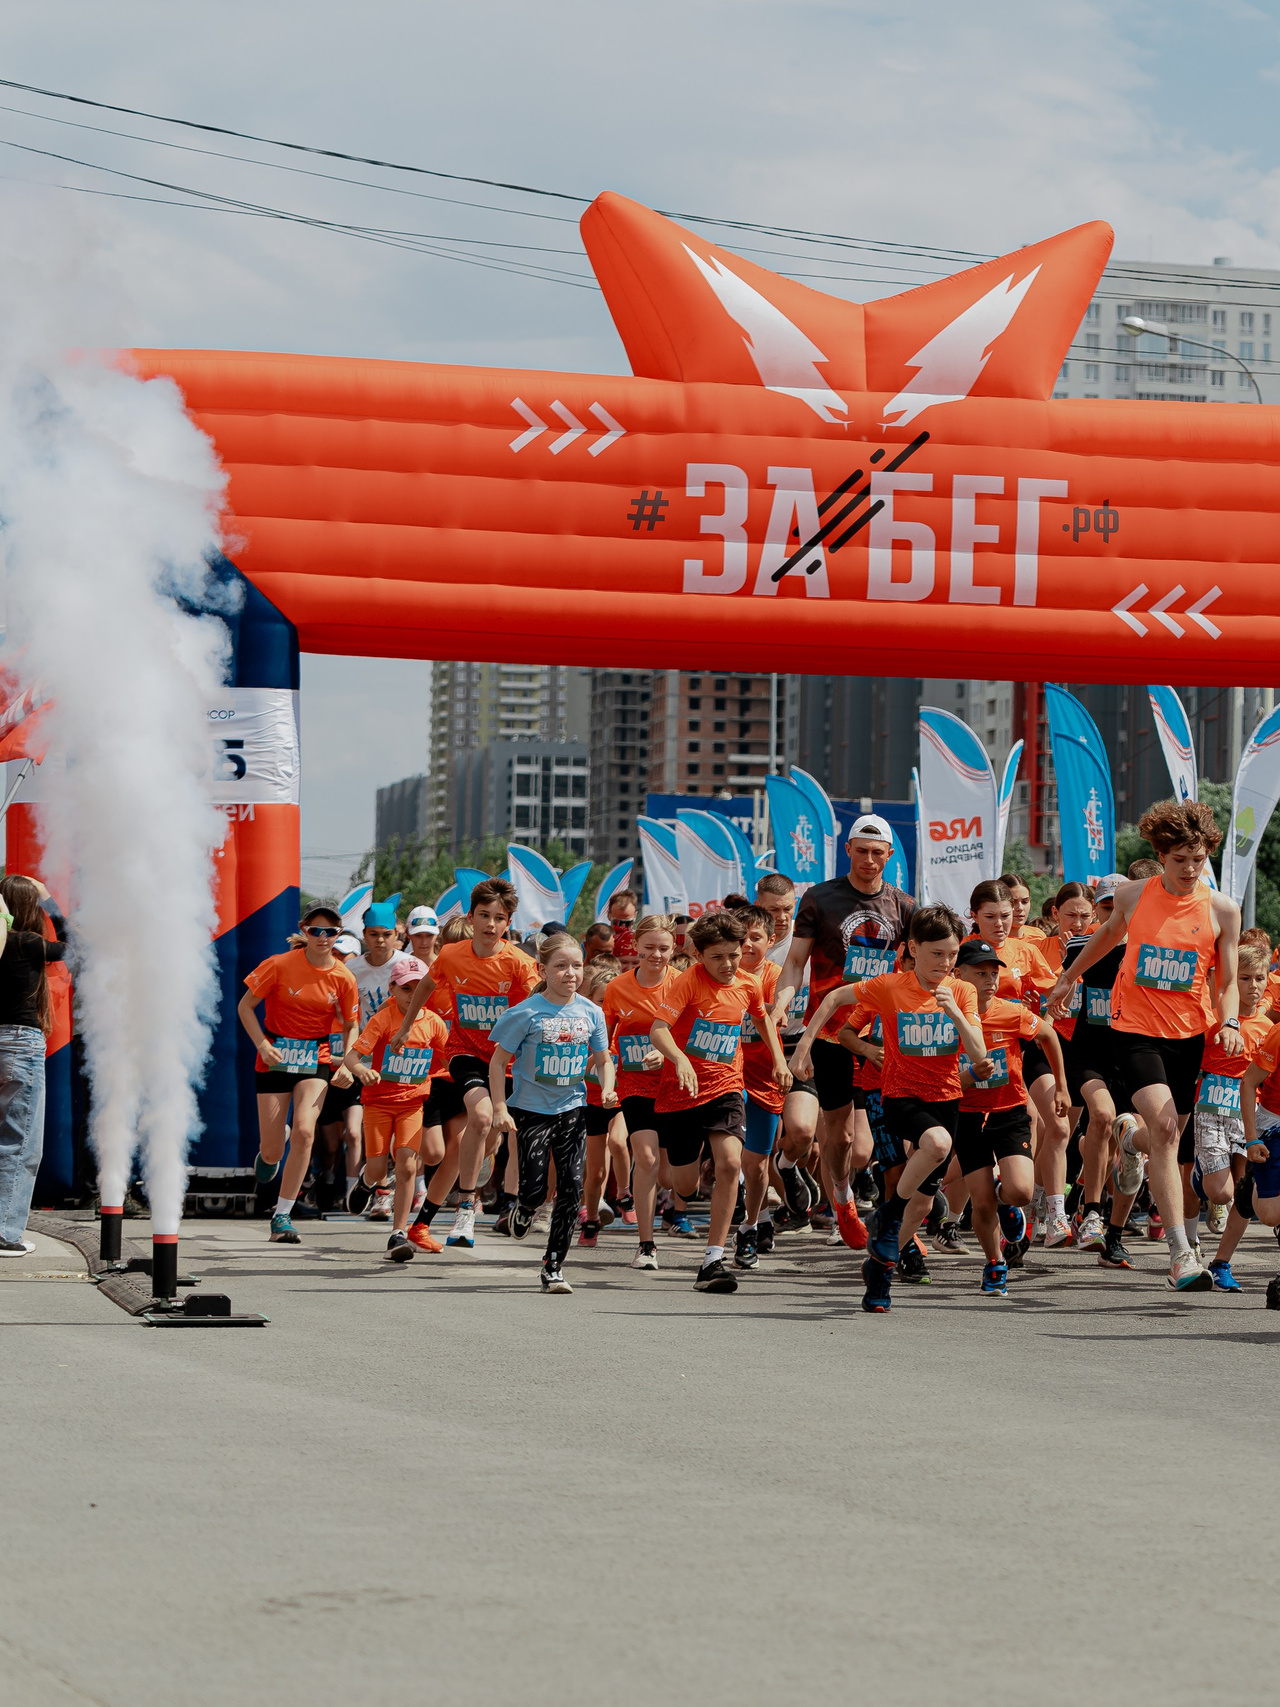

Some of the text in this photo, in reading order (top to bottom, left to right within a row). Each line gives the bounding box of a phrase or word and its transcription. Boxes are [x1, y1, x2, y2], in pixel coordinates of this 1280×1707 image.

[851, 956, 889, 977] 10130
[1144, 956, 1190, 982] 10100
[1157, 980, 1172, 990] 1KM
[478, 1022, 492, 1030] 1KM
[903, 1023, 954, 1045] 10046
[693, 1030, 736, 1054] 10076
[705, 1052, 719, 1061] 1KM
[922, 1047, 937, 1057] 1KM
[287, 1066, 300, 1074] 1KM
[388, 1055, 428, 1076] 10077
[543, 1055, 584, 1076] 10012
[400, 1075, 412, 1084] 1KM
[557, 1076, 570, 1086] 1KM
[1218, 1106, 1231, 1116] 1KM
